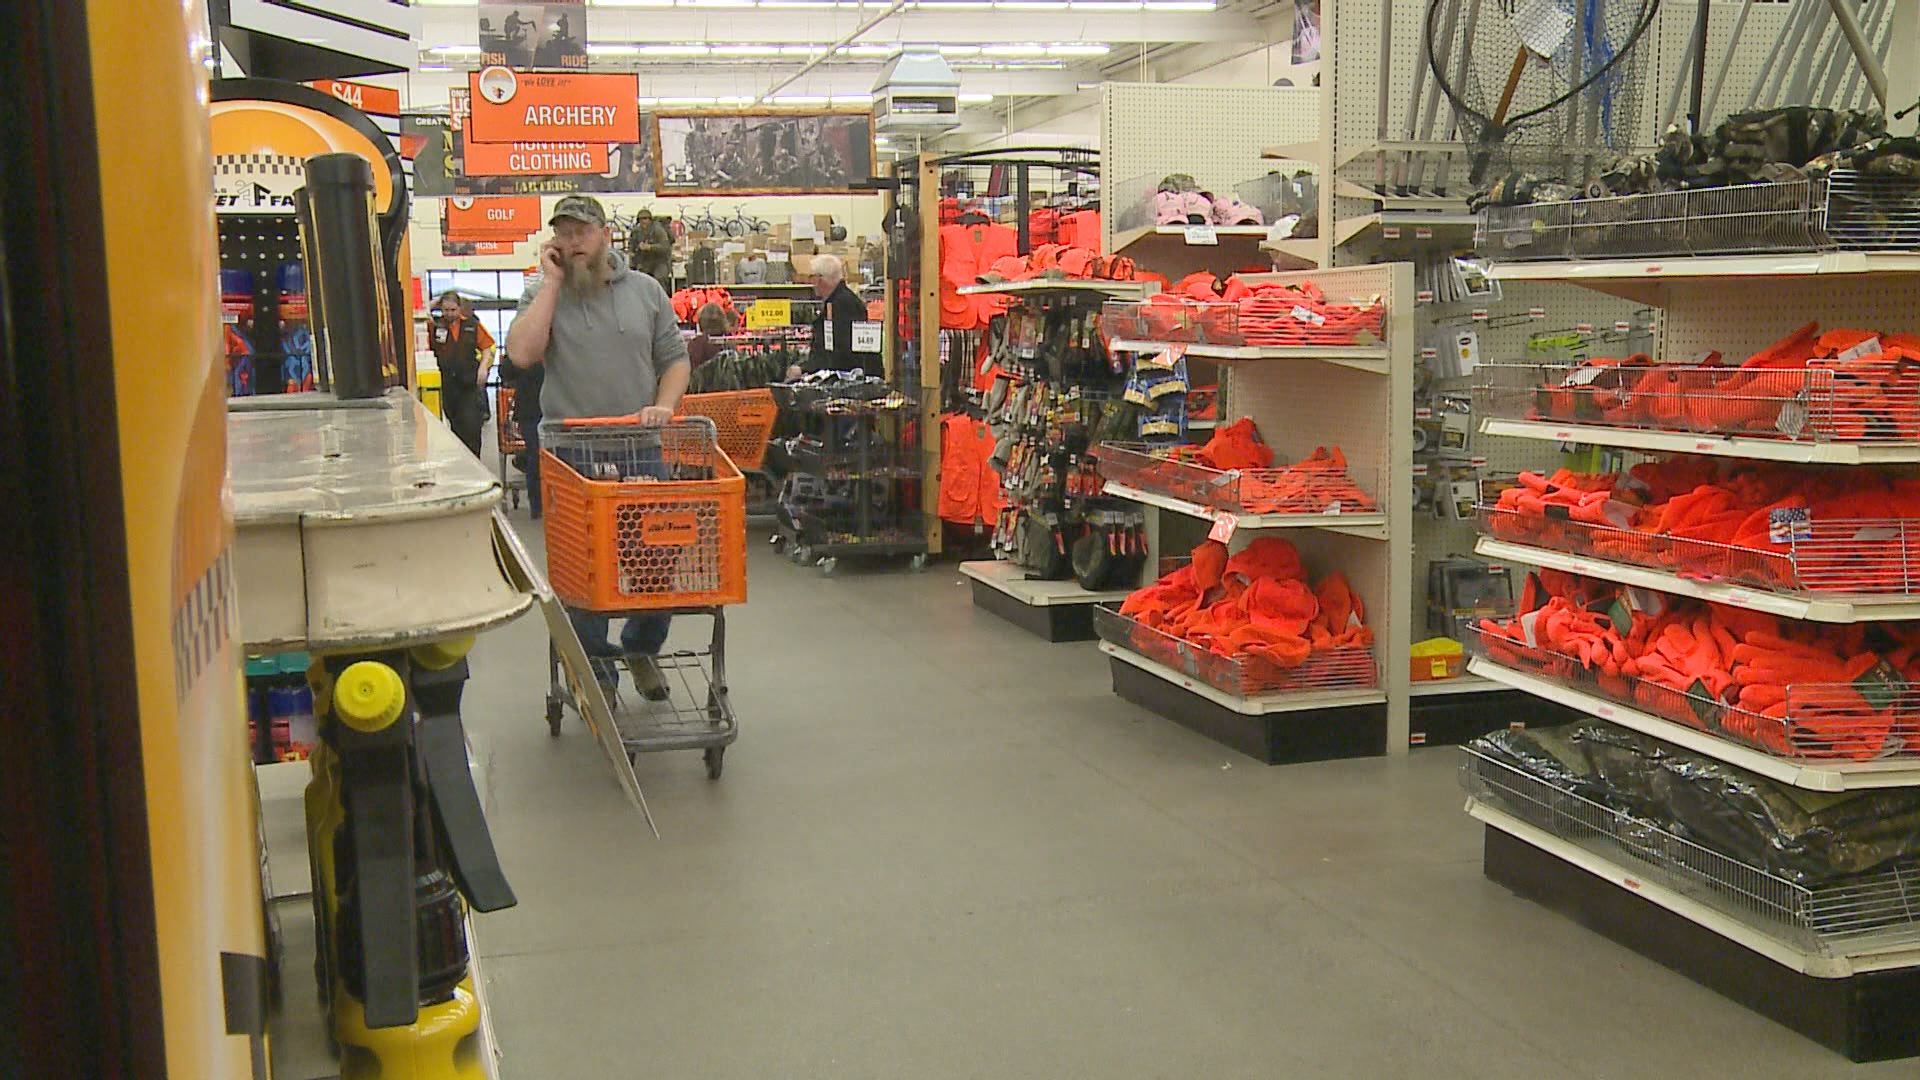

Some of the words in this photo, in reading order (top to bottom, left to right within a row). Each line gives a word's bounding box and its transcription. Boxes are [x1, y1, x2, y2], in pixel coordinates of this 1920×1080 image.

[561, 55, 588, 67] RIDE
[415, 116, 442, 126] GREAT
[524, 105, 617, 127] ARCHERY
[509, 152, 593, 171] CLOTHING
[270, 195, 295, 206] FA
[486, 208, 516, 221] GOLF
